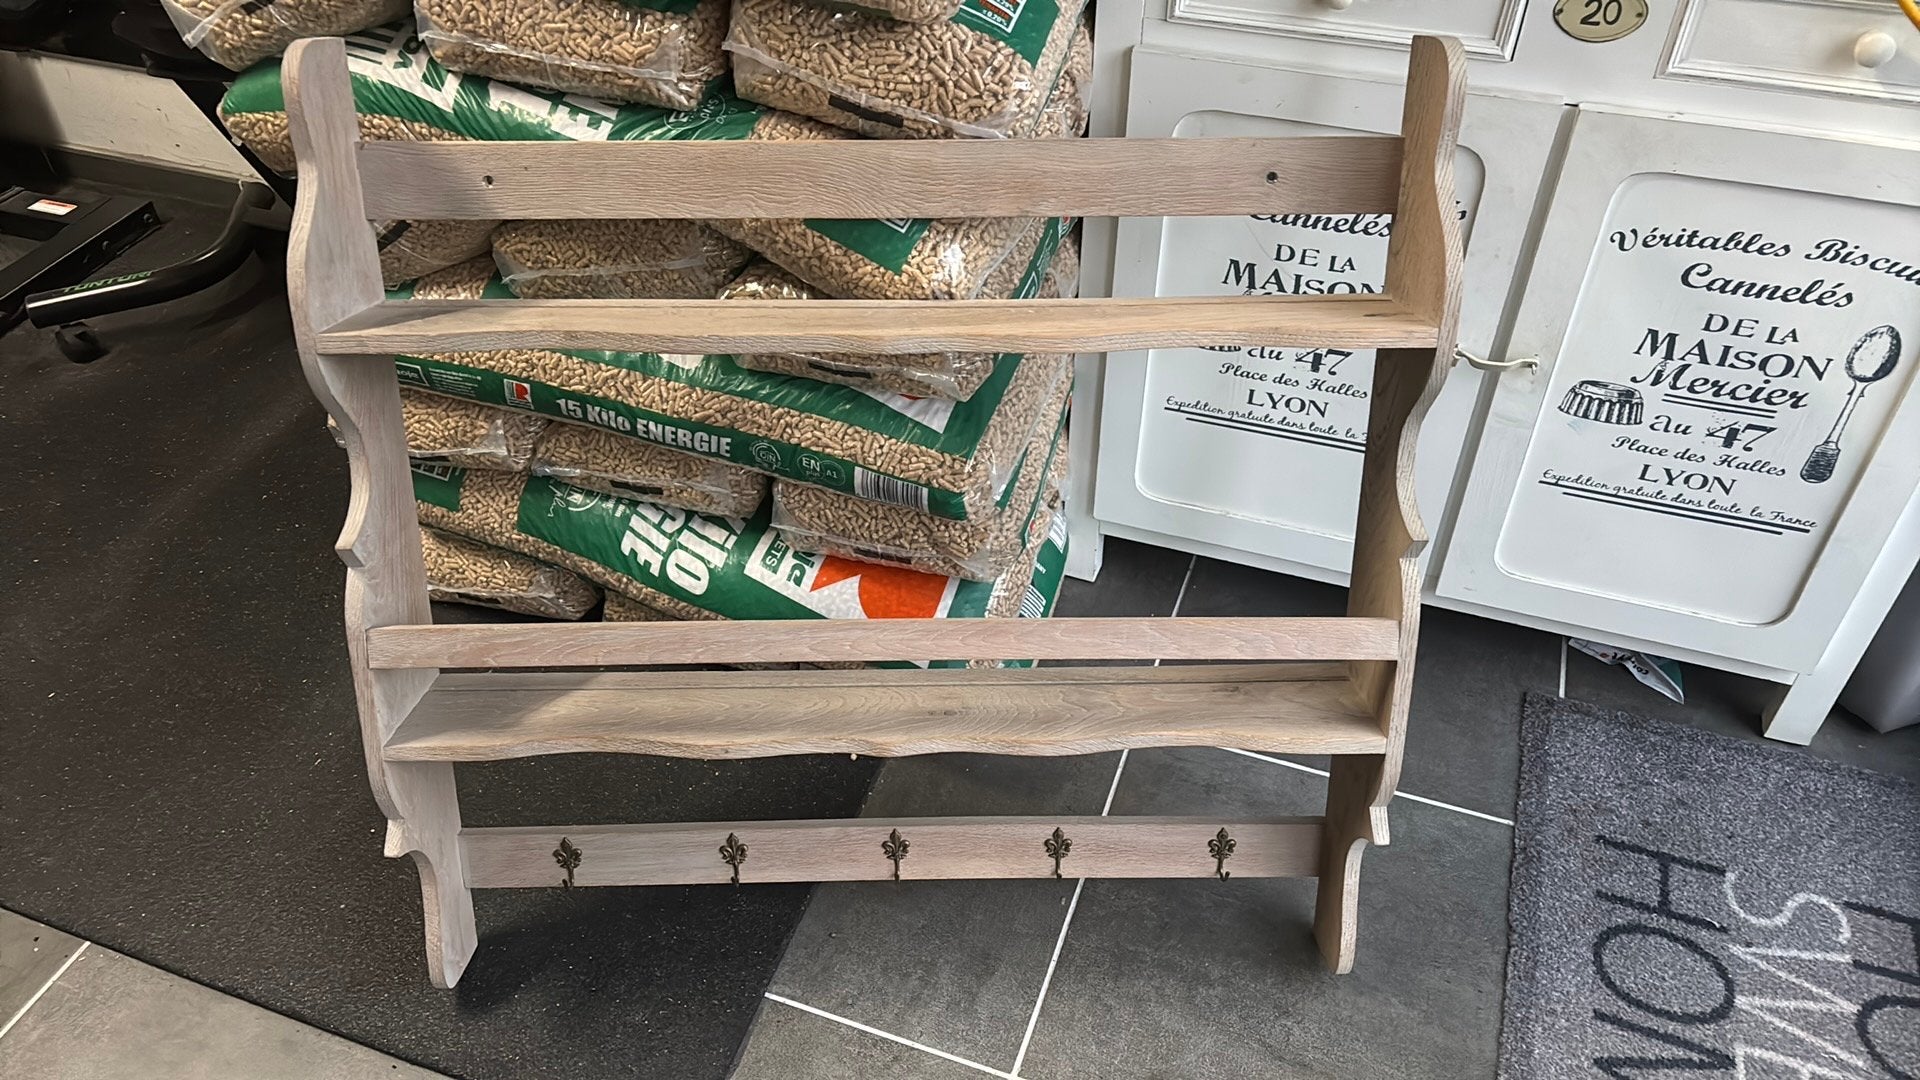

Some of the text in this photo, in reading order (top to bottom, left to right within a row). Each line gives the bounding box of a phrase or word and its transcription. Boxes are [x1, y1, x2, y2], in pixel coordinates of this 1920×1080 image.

[1580, 0, 1622, 26] 20
[1274, 243, 1356, 273] DE LA
[1609, 227, 1920, 286] Véritables Biscu
[1680, 262, 1854, 308] Cannelés
[1701, 313, 1799, 345] DE LA
[1295, 347, 1353, 376] 47
[1633, 328, 1834, 382] MAISON
[1219, 362, 1368, 399] Place des Halles
[1630, 359, 1810, 409] Mercier
[1247, 389, 1329, 418] LYON
[556, 398, 732, 457] 15 Kilo ENERGIE
[1227, 409, 1275, 424] gratuite
[1277, 417, 1306, 430] dans
[1308, 422, 1339, 436] toute
[1345, 428, 1359, 440] la
[1650, 414, 1778, 452] au 47
[802, 458, 821, 472] EN
[826, 469, 838, 478] A1
[1611, 436, 1786, 477] Place des Halles
[1638, 463, 1738, 496] LYON
[1613, 484, 1667, 501] gratuite
[1670, 491, 1704, 507] dans
[1707, 496, 1742, 515] toute
[1750, 505, 1768, 518] la
[1770, 511, 1817, 529] France
